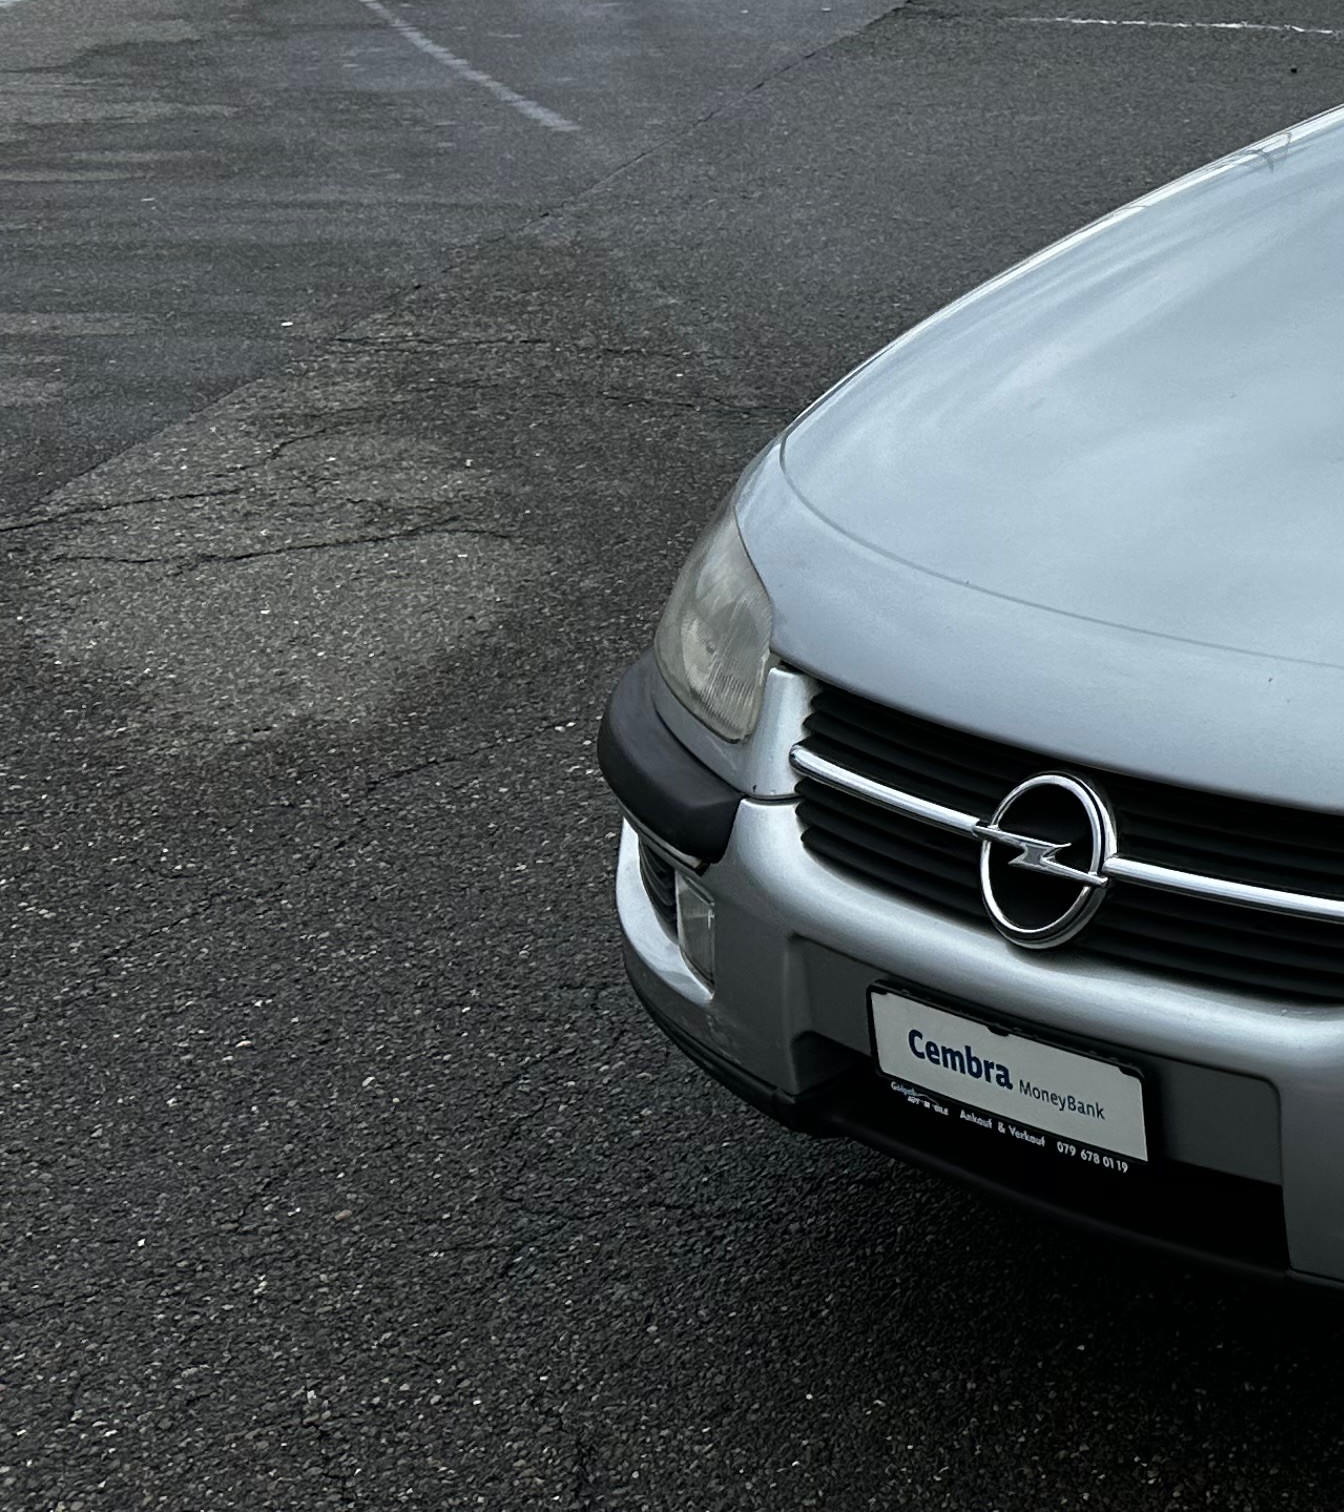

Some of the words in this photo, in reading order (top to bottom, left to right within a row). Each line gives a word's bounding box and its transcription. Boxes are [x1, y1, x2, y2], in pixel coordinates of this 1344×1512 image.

[907, 1029, 1013, 1090] Cembra
[1019, 1079, 1106, 1120] MoneyBank
[959, 1108, 993, 1129] Ankauf
[997, 1121, 1006, 1134] &
[1008, 1124, 1046, 1148] Verkauf
[1056, 1140, 1077, 1157] 079
[1080, 1149, 1101, 1165] 678
